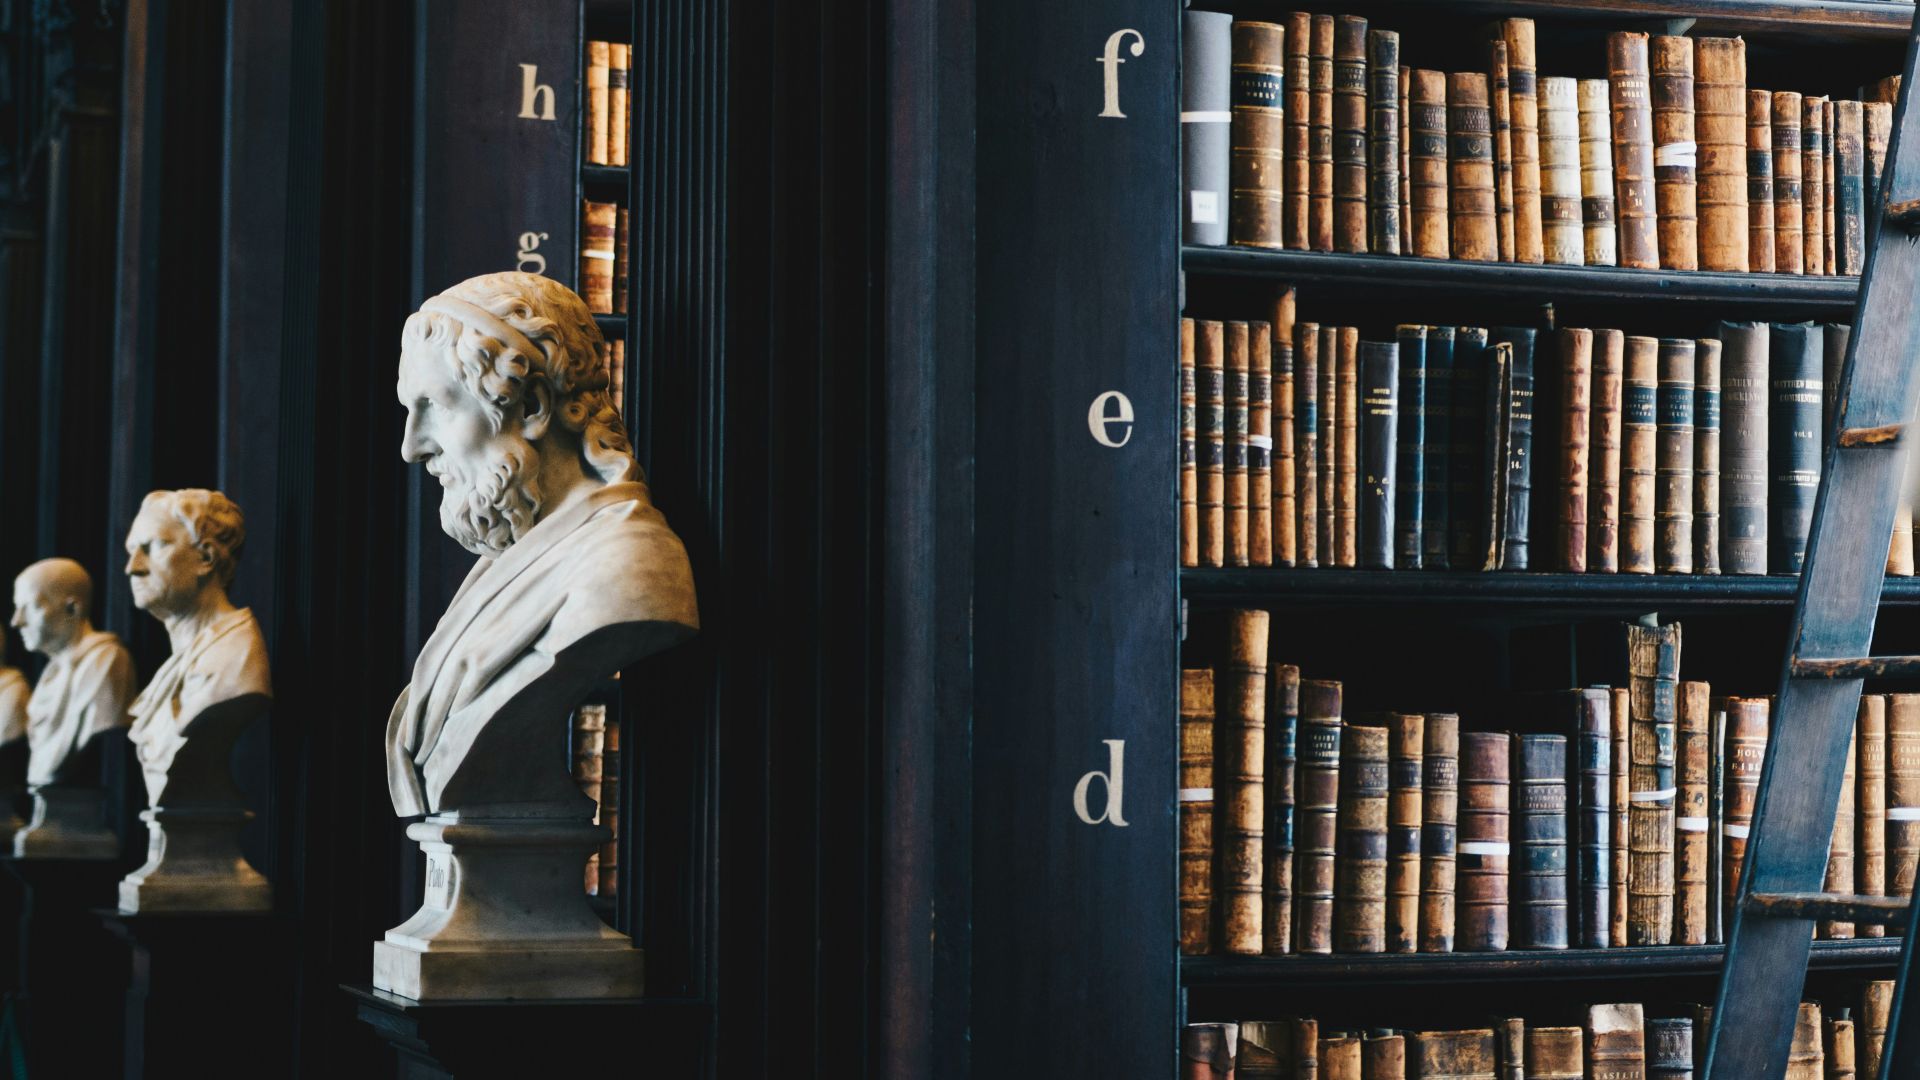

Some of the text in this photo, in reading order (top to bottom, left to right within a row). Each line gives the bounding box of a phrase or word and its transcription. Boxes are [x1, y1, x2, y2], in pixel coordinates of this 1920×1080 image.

[517, 63, 557, 121] h
[1095, 28, 1145, 119] f
[517, 231, 549, 275] g
[1087, 390, 1135, 448] e
[1737, 748, 1764, 758] HOLY
[1073, 739, 1129, 827] d
